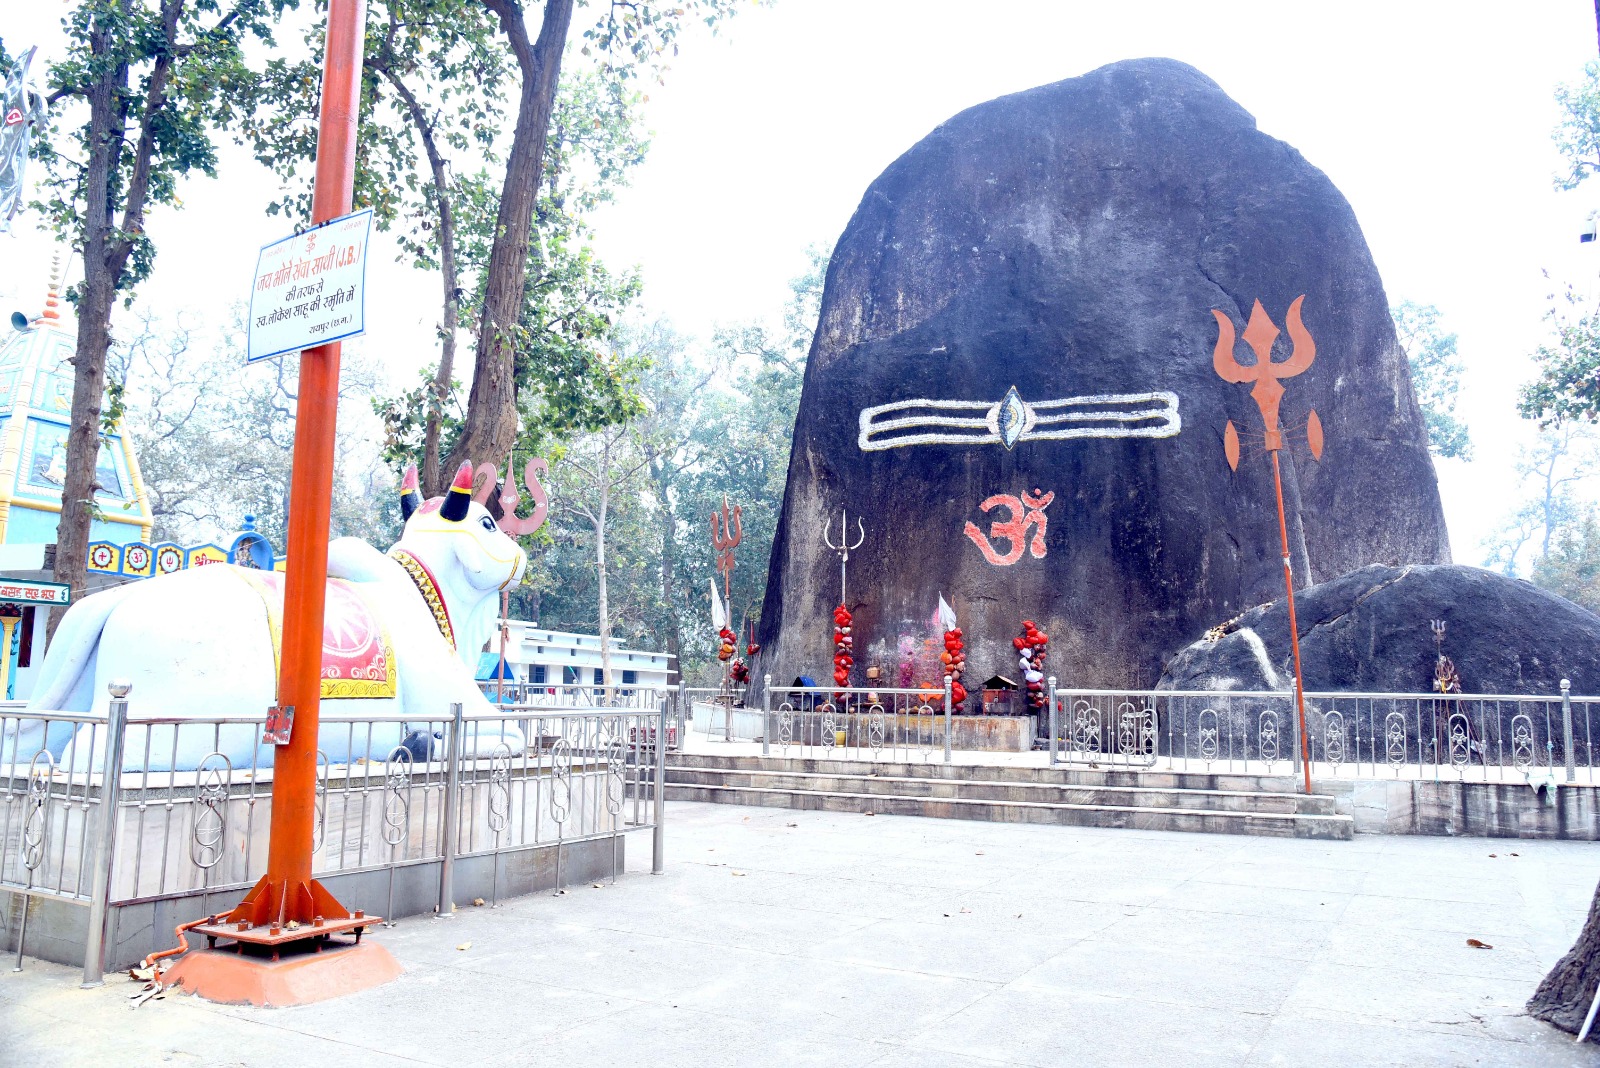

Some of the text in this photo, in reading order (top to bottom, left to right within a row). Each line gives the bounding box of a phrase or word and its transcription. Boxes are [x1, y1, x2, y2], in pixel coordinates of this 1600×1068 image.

[257, 273, 273, 291] जय
[273, 259, 293, 287] भोले
[292, 257, 310, 281] सेवा
[311, 245, 336, 275] साथी
[336, 241, 362, 269] (J.B.)
[285, 278, 325, 302] की तरफ से
[310, 295, 321, 312] की
[323, 288, 344, 311] स्मृति
[345, 284, 357, 301] में
[308, 320, 330, 335] रायपुर
